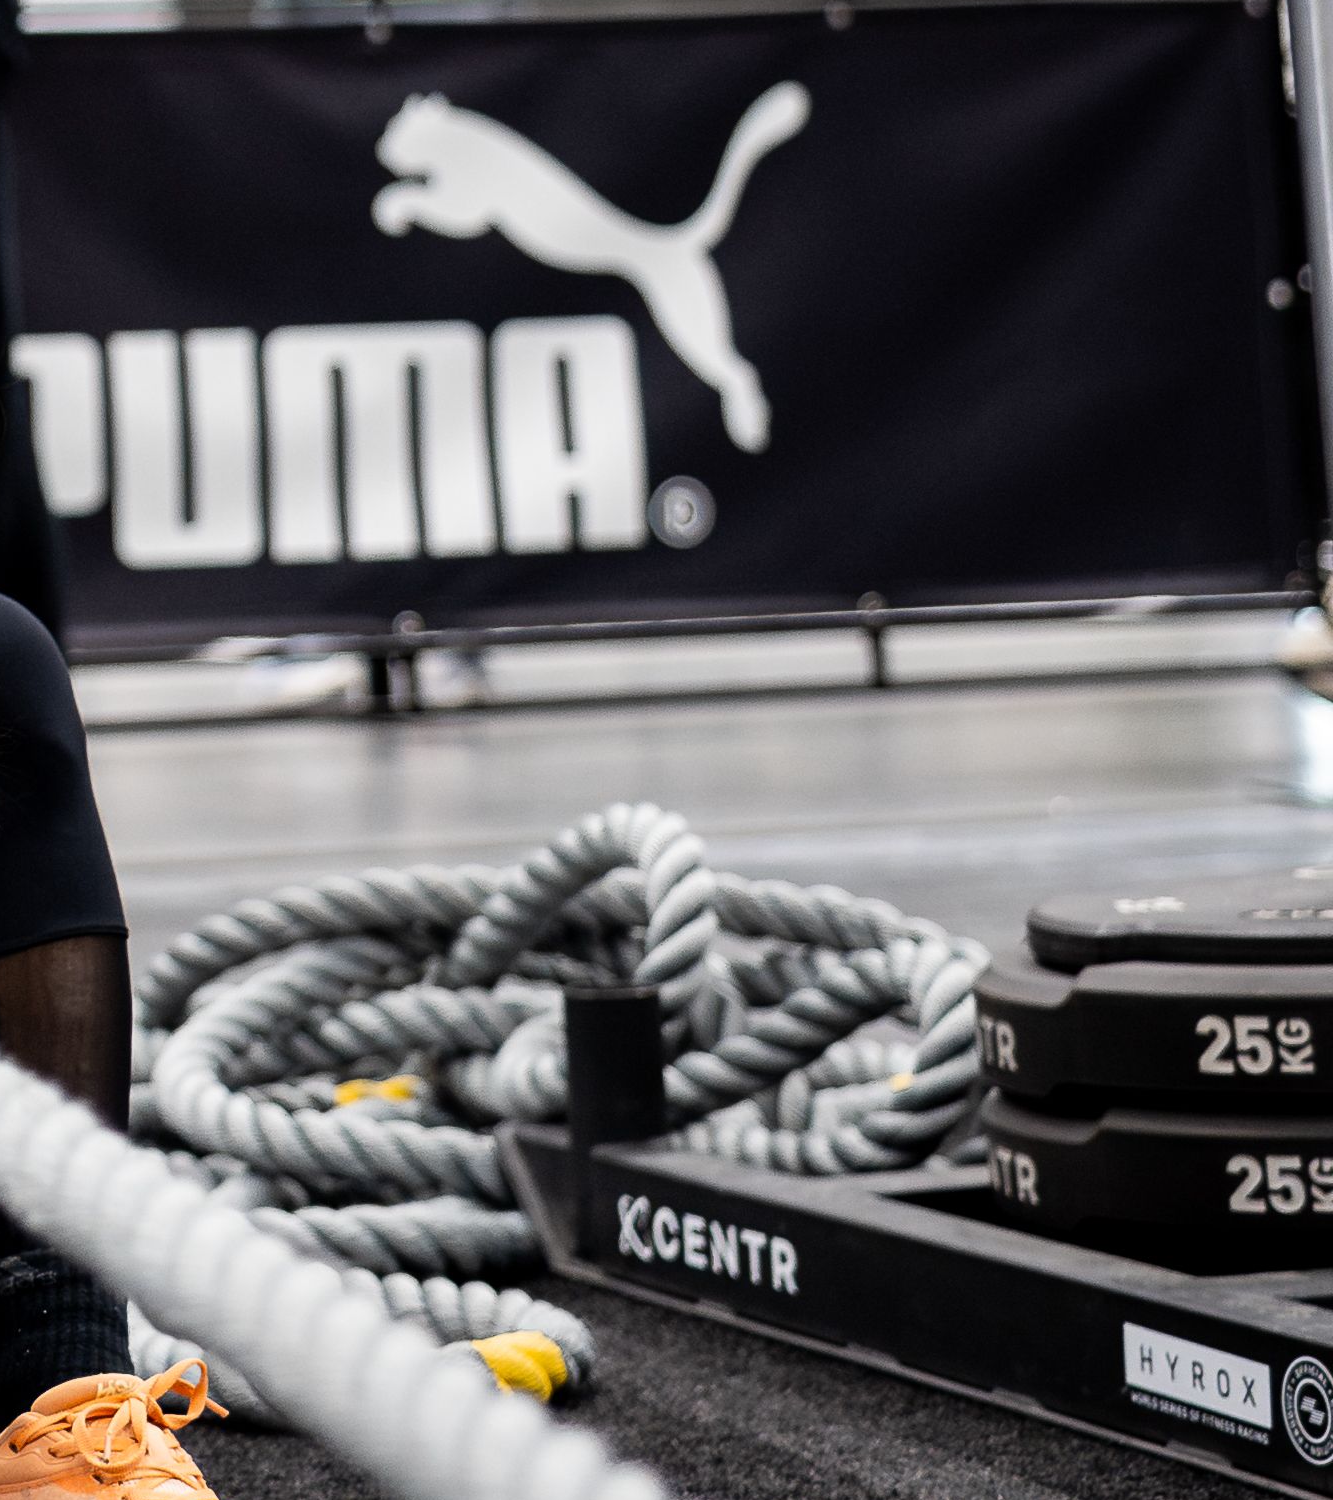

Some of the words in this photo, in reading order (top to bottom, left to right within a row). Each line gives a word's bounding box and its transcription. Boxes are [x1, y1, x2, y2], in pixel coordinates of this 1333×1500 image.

[1195, 1014, 1275, 1075] 25
[1226, 1153, 1306, 1214] 25
[652, 1205, 799, 1296] CENTR
[1139, 1343, 1257, 1408] HYROX
